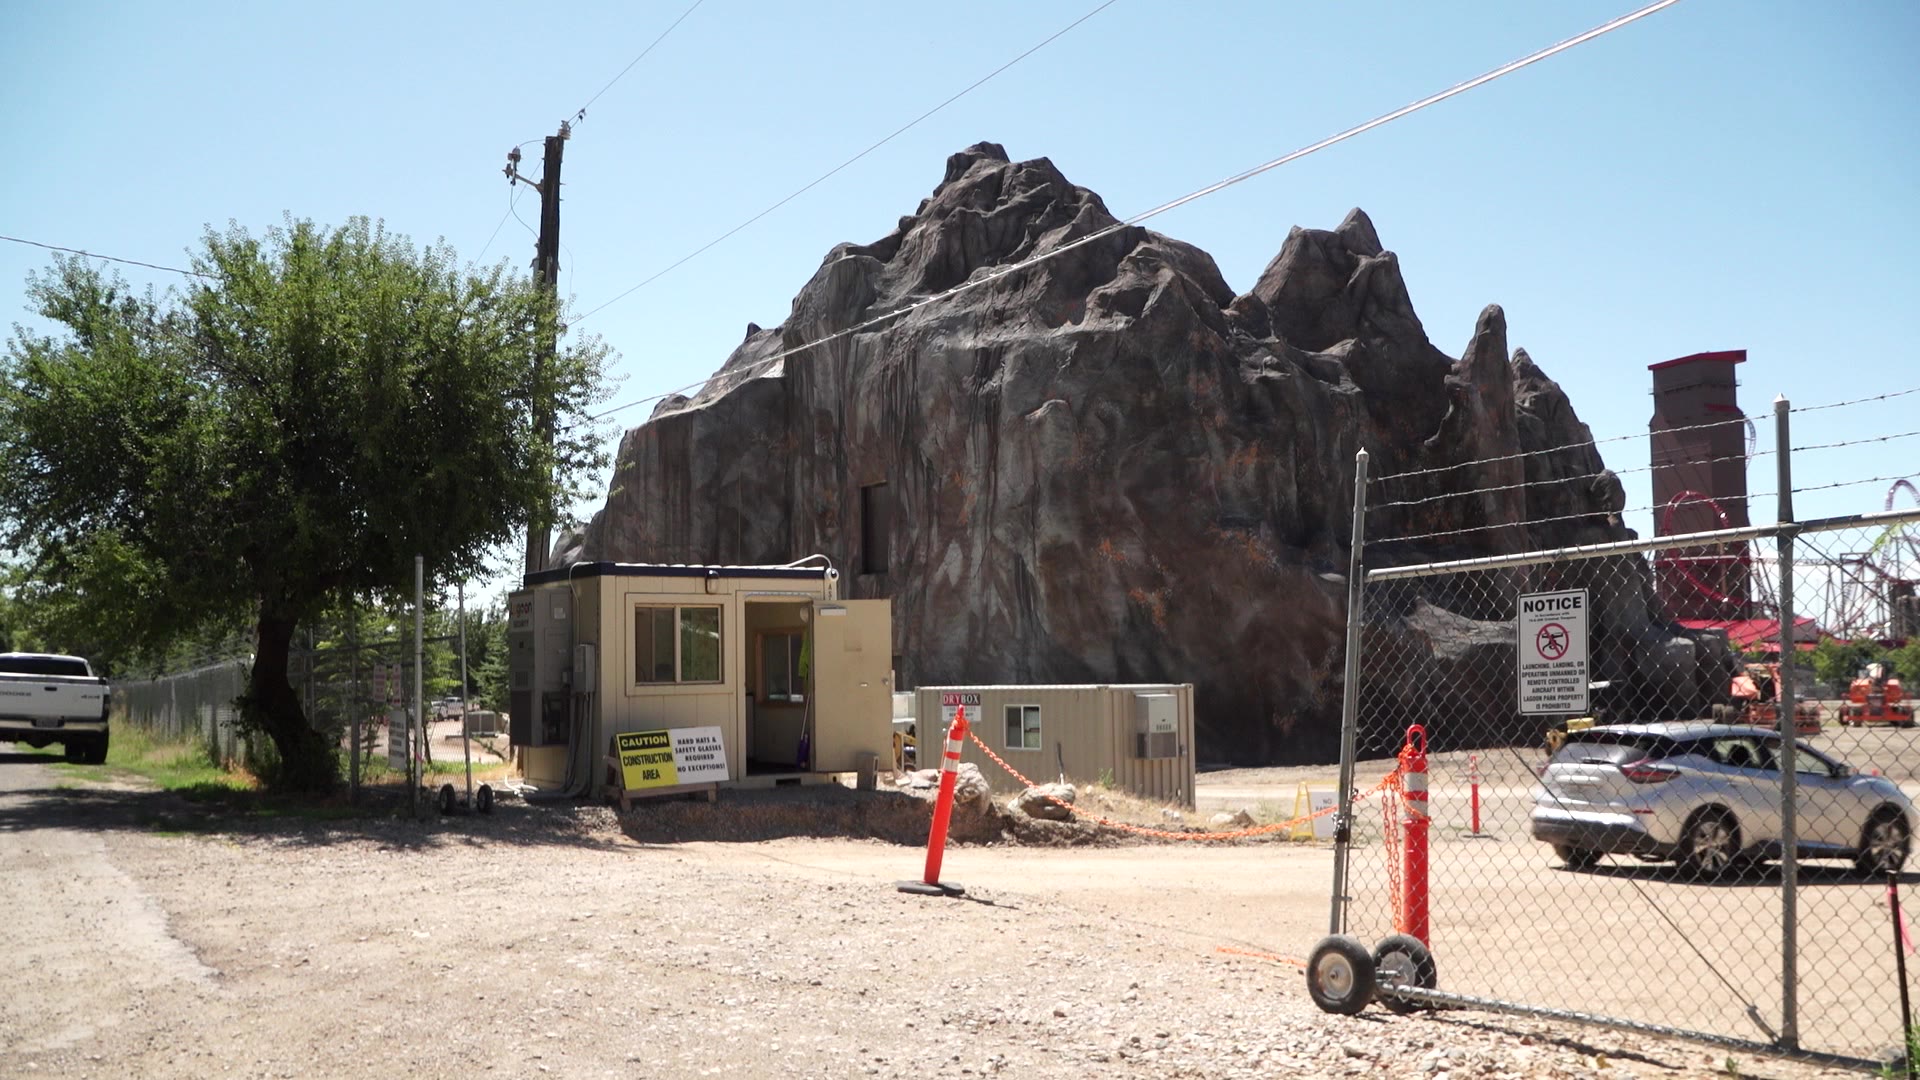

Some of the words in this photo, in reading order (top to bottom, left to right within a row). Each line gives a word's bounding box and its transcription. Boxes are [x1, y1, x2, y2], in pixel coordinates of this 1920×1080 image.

[1523, 597, 1582, 613] NOTICE
[1549, 669, 1577, 677] UNMANNED
[1548, 677, 1580, 685] CONTROLLED
[943, 694, 980, 704] DRYBOX
[621, 735, 668, 748] CAUTION
[675, 746, 696, 754] SAFETY
[697, 744, 722, 752] GLASSES
[622, 752, 673, 767] CONSTRUCTION
[685, 753, 715, 761] REQUIRED
[688, 763, 726, 772] EXCEPTIONS!
[642, 768, 661, 780] AREA
